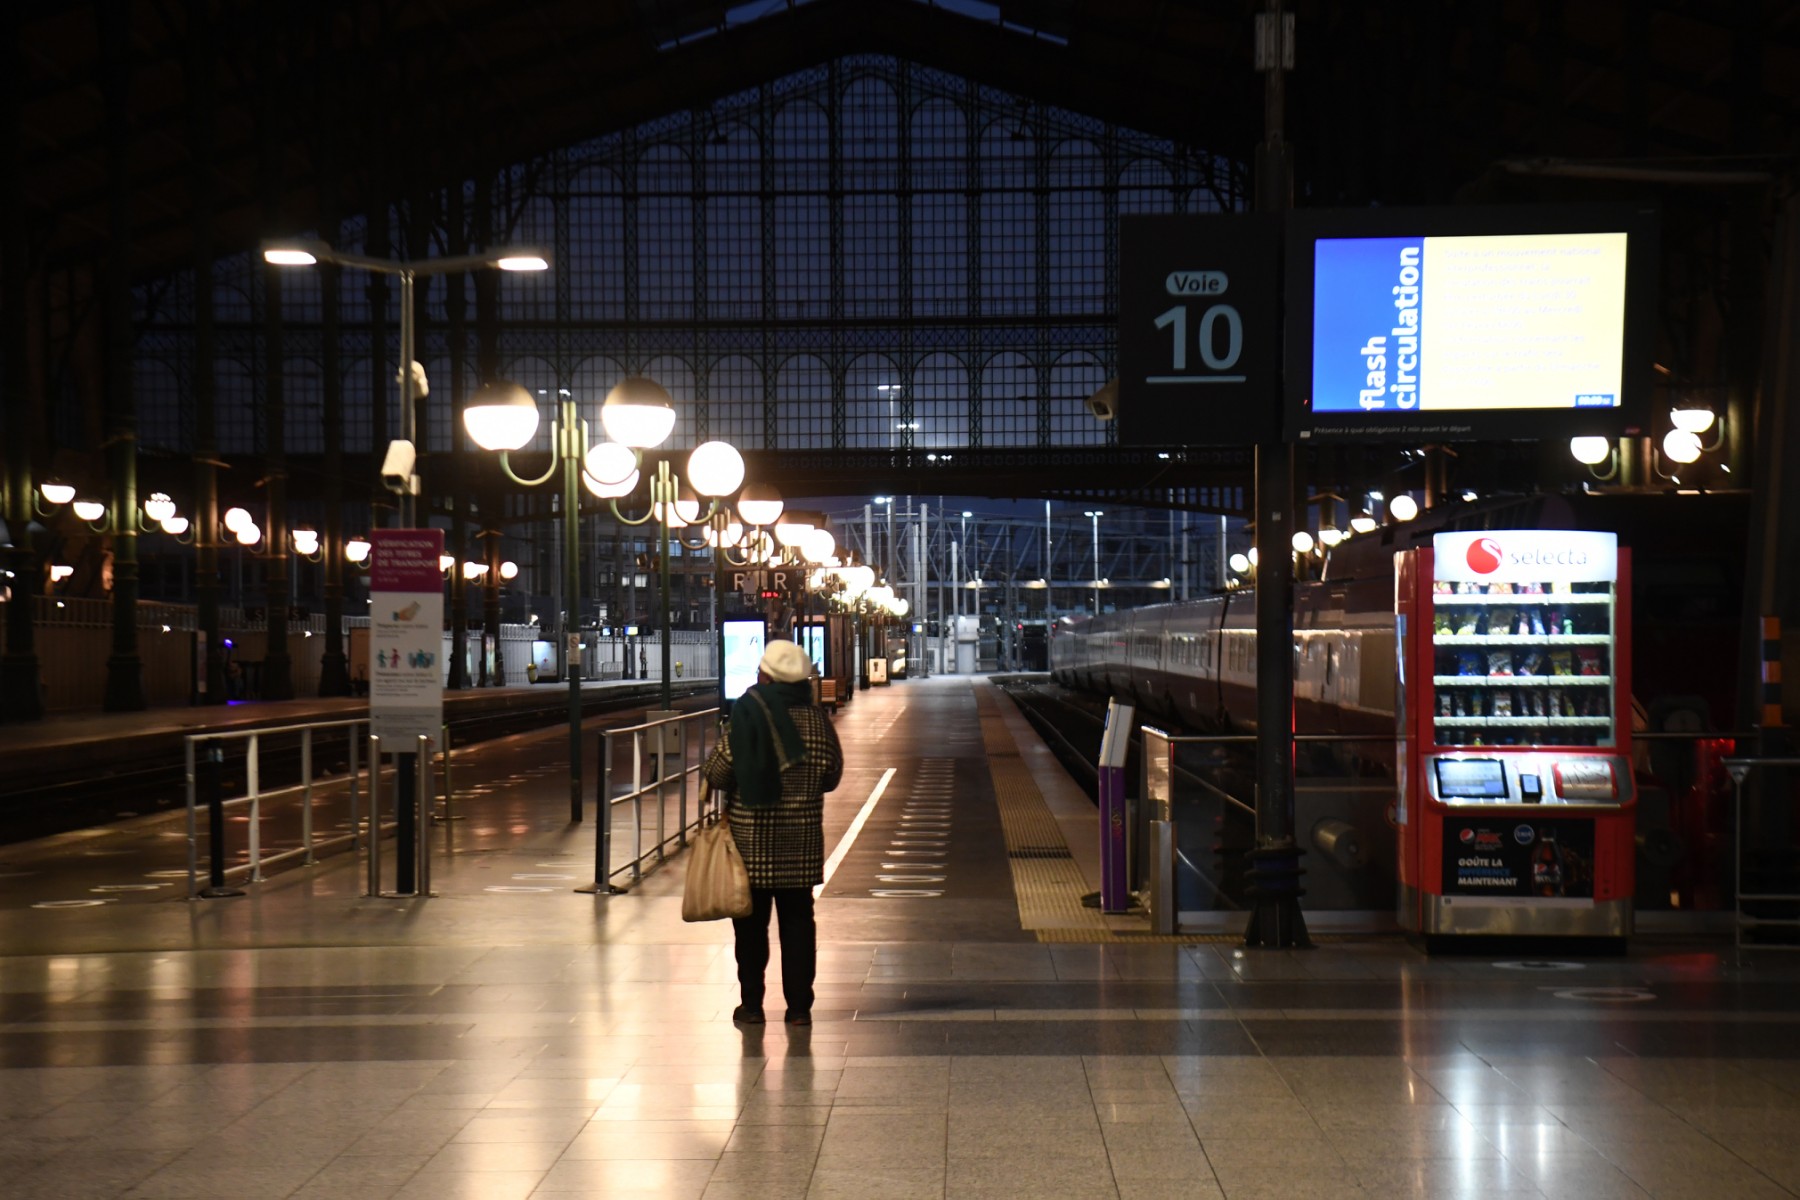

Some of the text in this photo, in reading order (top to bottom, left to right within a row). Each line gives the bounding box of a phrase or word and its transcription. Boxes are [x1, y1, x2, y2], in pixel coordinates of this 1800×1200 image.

[1174, 275, 1220, 292] Voie
[1390, 246, 1420, 410] circulation
[1153, 304, 1243, 371] 10
[1359, 336, 1386, 410] flash
[1314, 426, 1344, 434] Présence
[1350, 426, 1365, 435] quai
[1365, 426, 1401, 435] obligatoire
[1401, 425, 1407, 433] 2
[1449, 425, 1472, 434] départ
[377, 559, 389, 567] DE
[1510, 548, 1588, 565] selecta
[774, 572, 788, 590] R
[1458, 856, 1503, 867] GOÛTE LA
[1457, 877, 1518, 886] MAINTENANT
